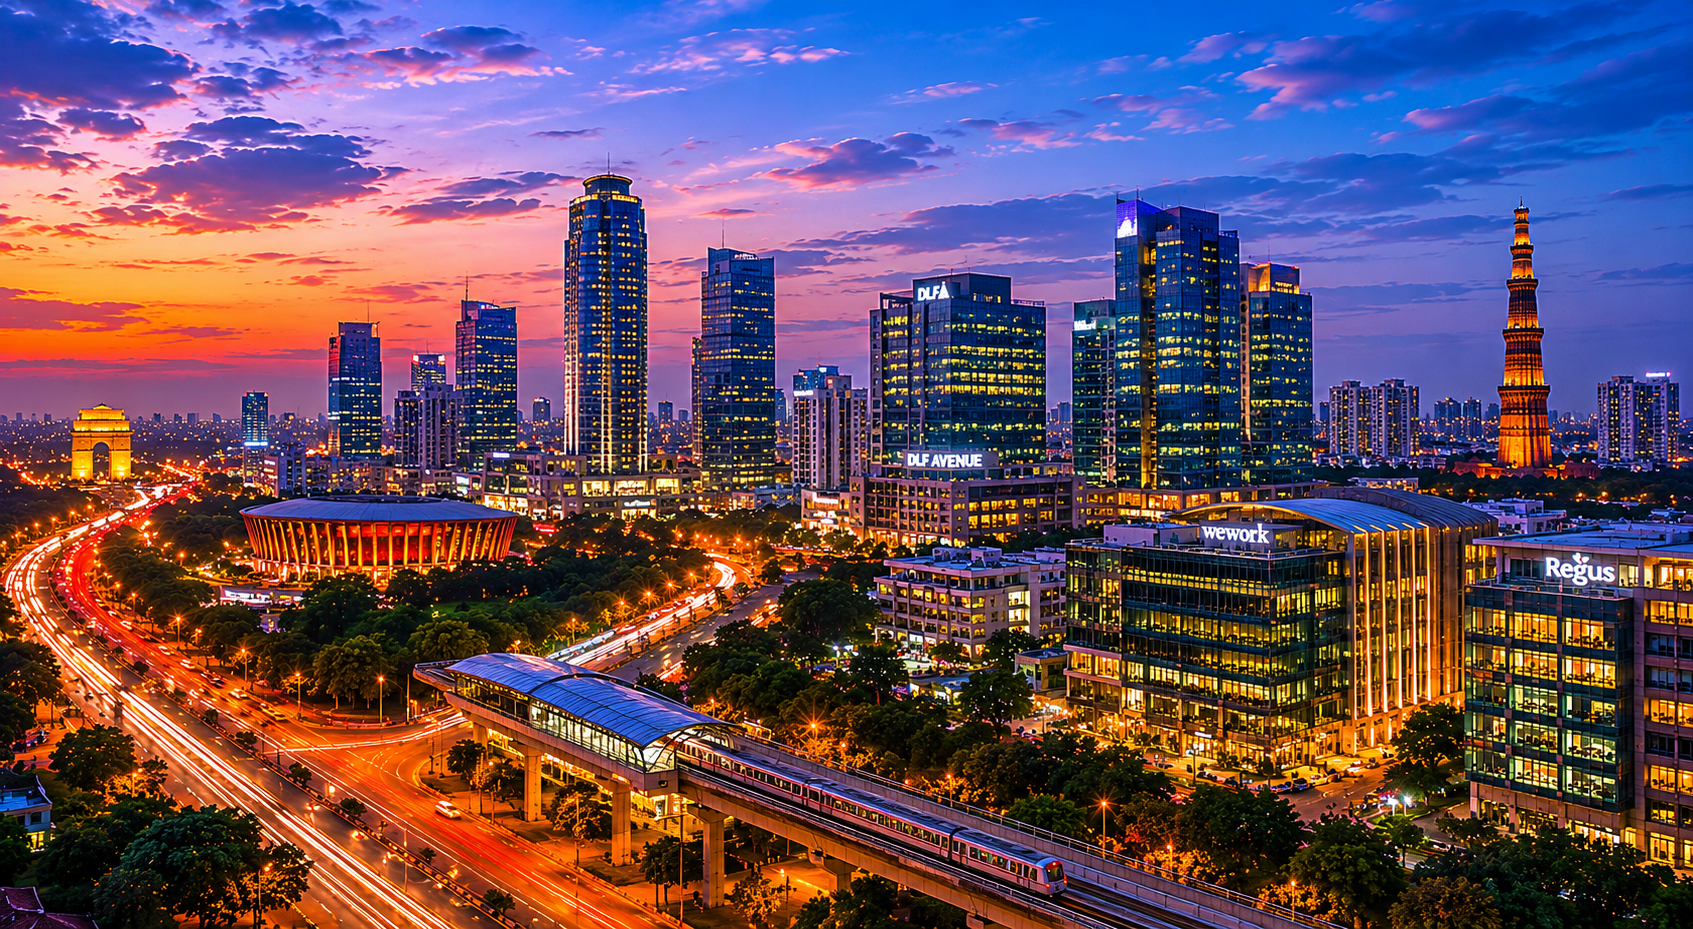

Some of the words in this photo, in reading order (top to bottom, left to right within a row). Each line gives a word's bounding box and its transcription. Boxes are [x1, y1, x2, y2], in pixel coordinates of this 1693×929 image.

[907, 453, 929, 467] DLF
[931, 454, 982, 468] AVENUE
[1201, 523, 1270, 544] wework
[1545, 557, 1616, 586] Regus
